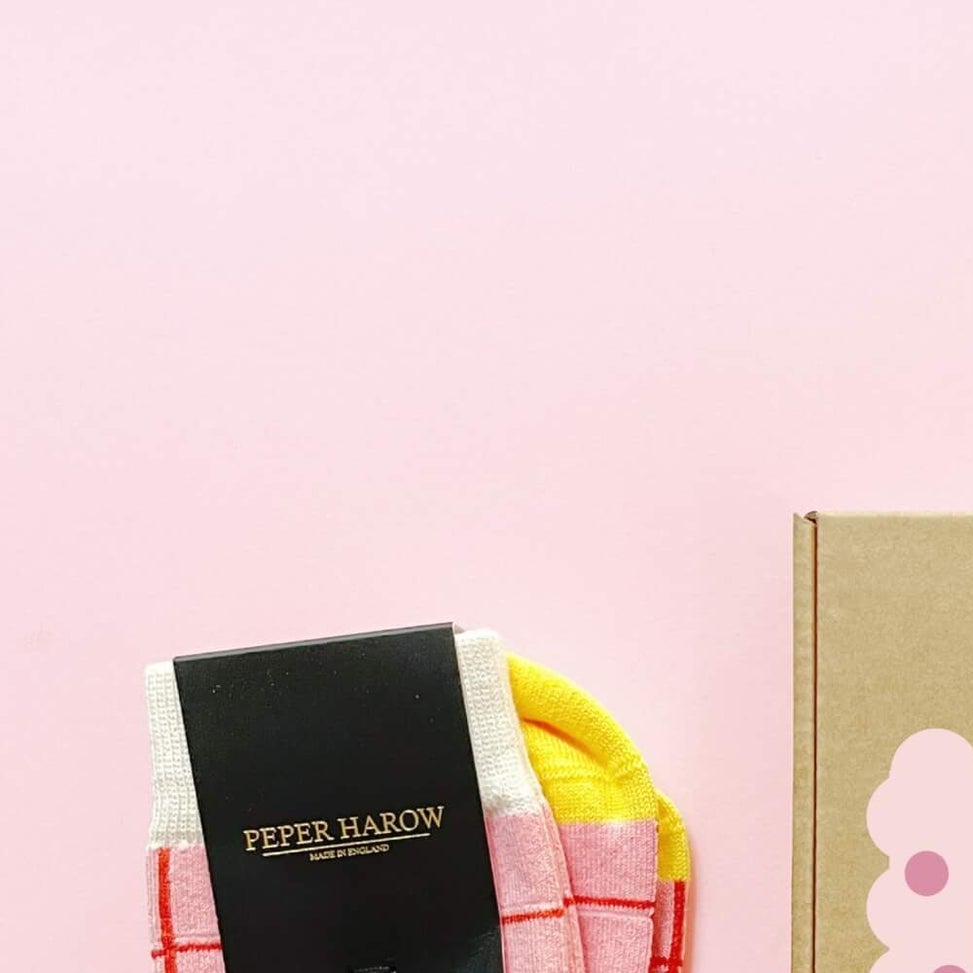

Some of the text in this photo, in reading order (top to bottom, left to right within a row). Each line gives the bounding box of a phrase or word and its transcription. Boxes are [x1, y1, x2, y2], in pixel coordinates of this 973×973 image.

[242, 805, 445, 851] PEPER HAROW
[309, 844, 390, 862] MADE IN ENGLAND
